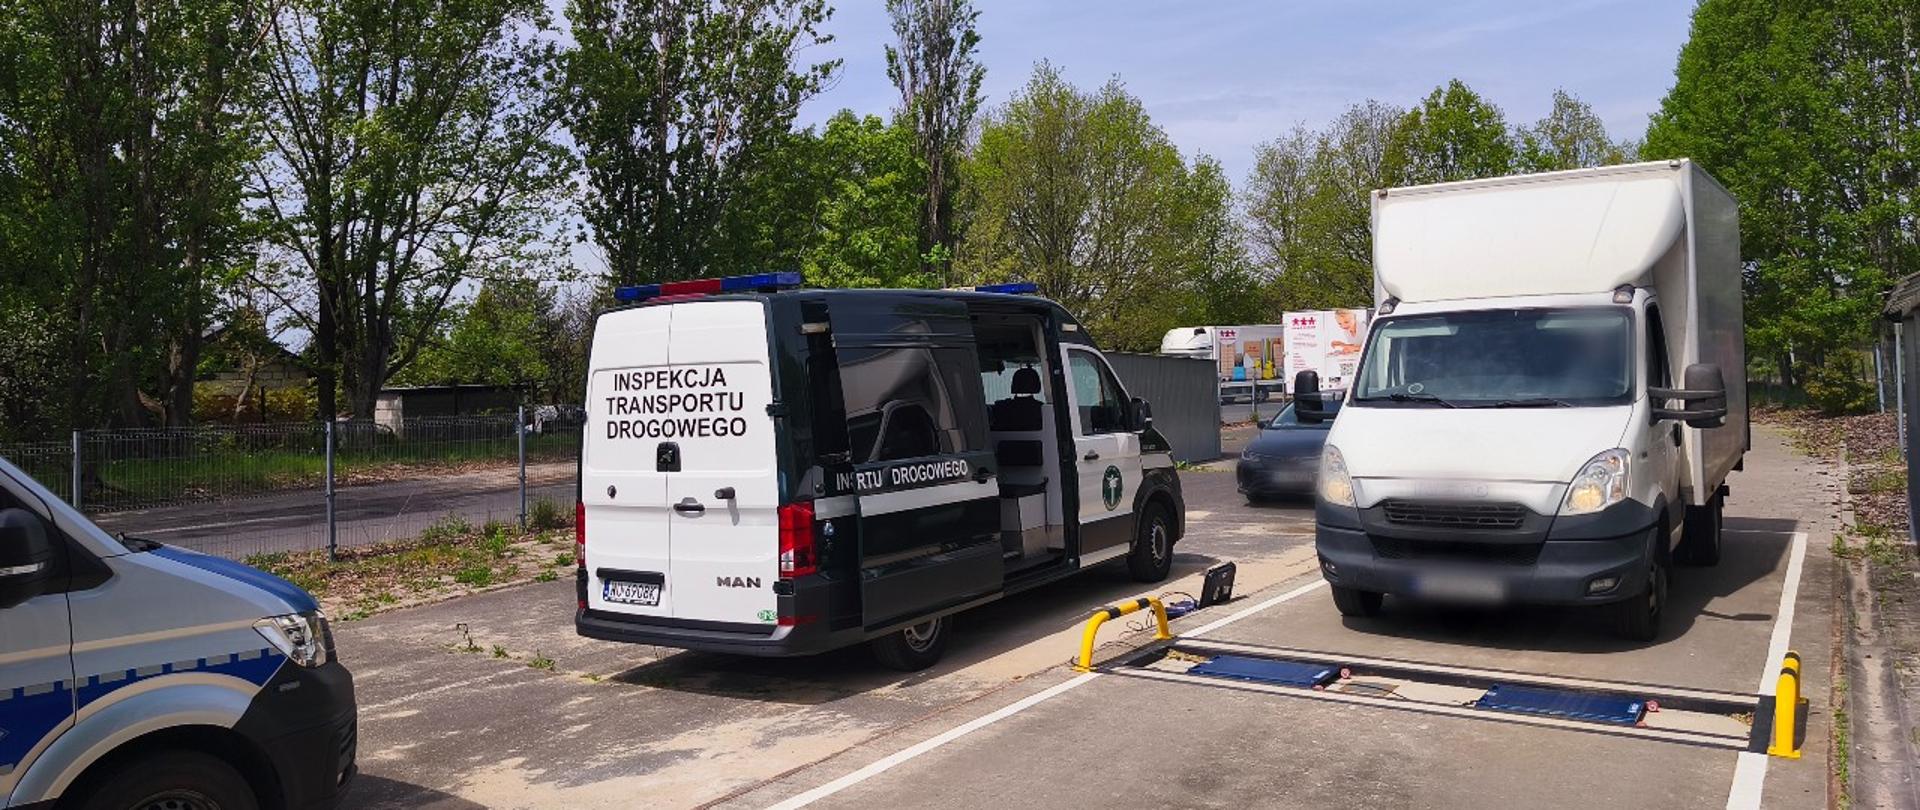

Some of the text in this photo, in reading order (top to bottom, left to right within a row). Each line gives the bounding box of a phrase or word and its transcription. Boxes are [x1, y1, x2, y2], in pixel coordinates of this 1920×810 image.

[614, 368, 727, 391] INSPEKCJA
[606, 392, 744, 415] TRANSPORTU
[607, 417, 747, 439] DROGOWEGO
[892, 460, 968, 485] DROGOWEGO
[717, 576, 761, 588] MAN
